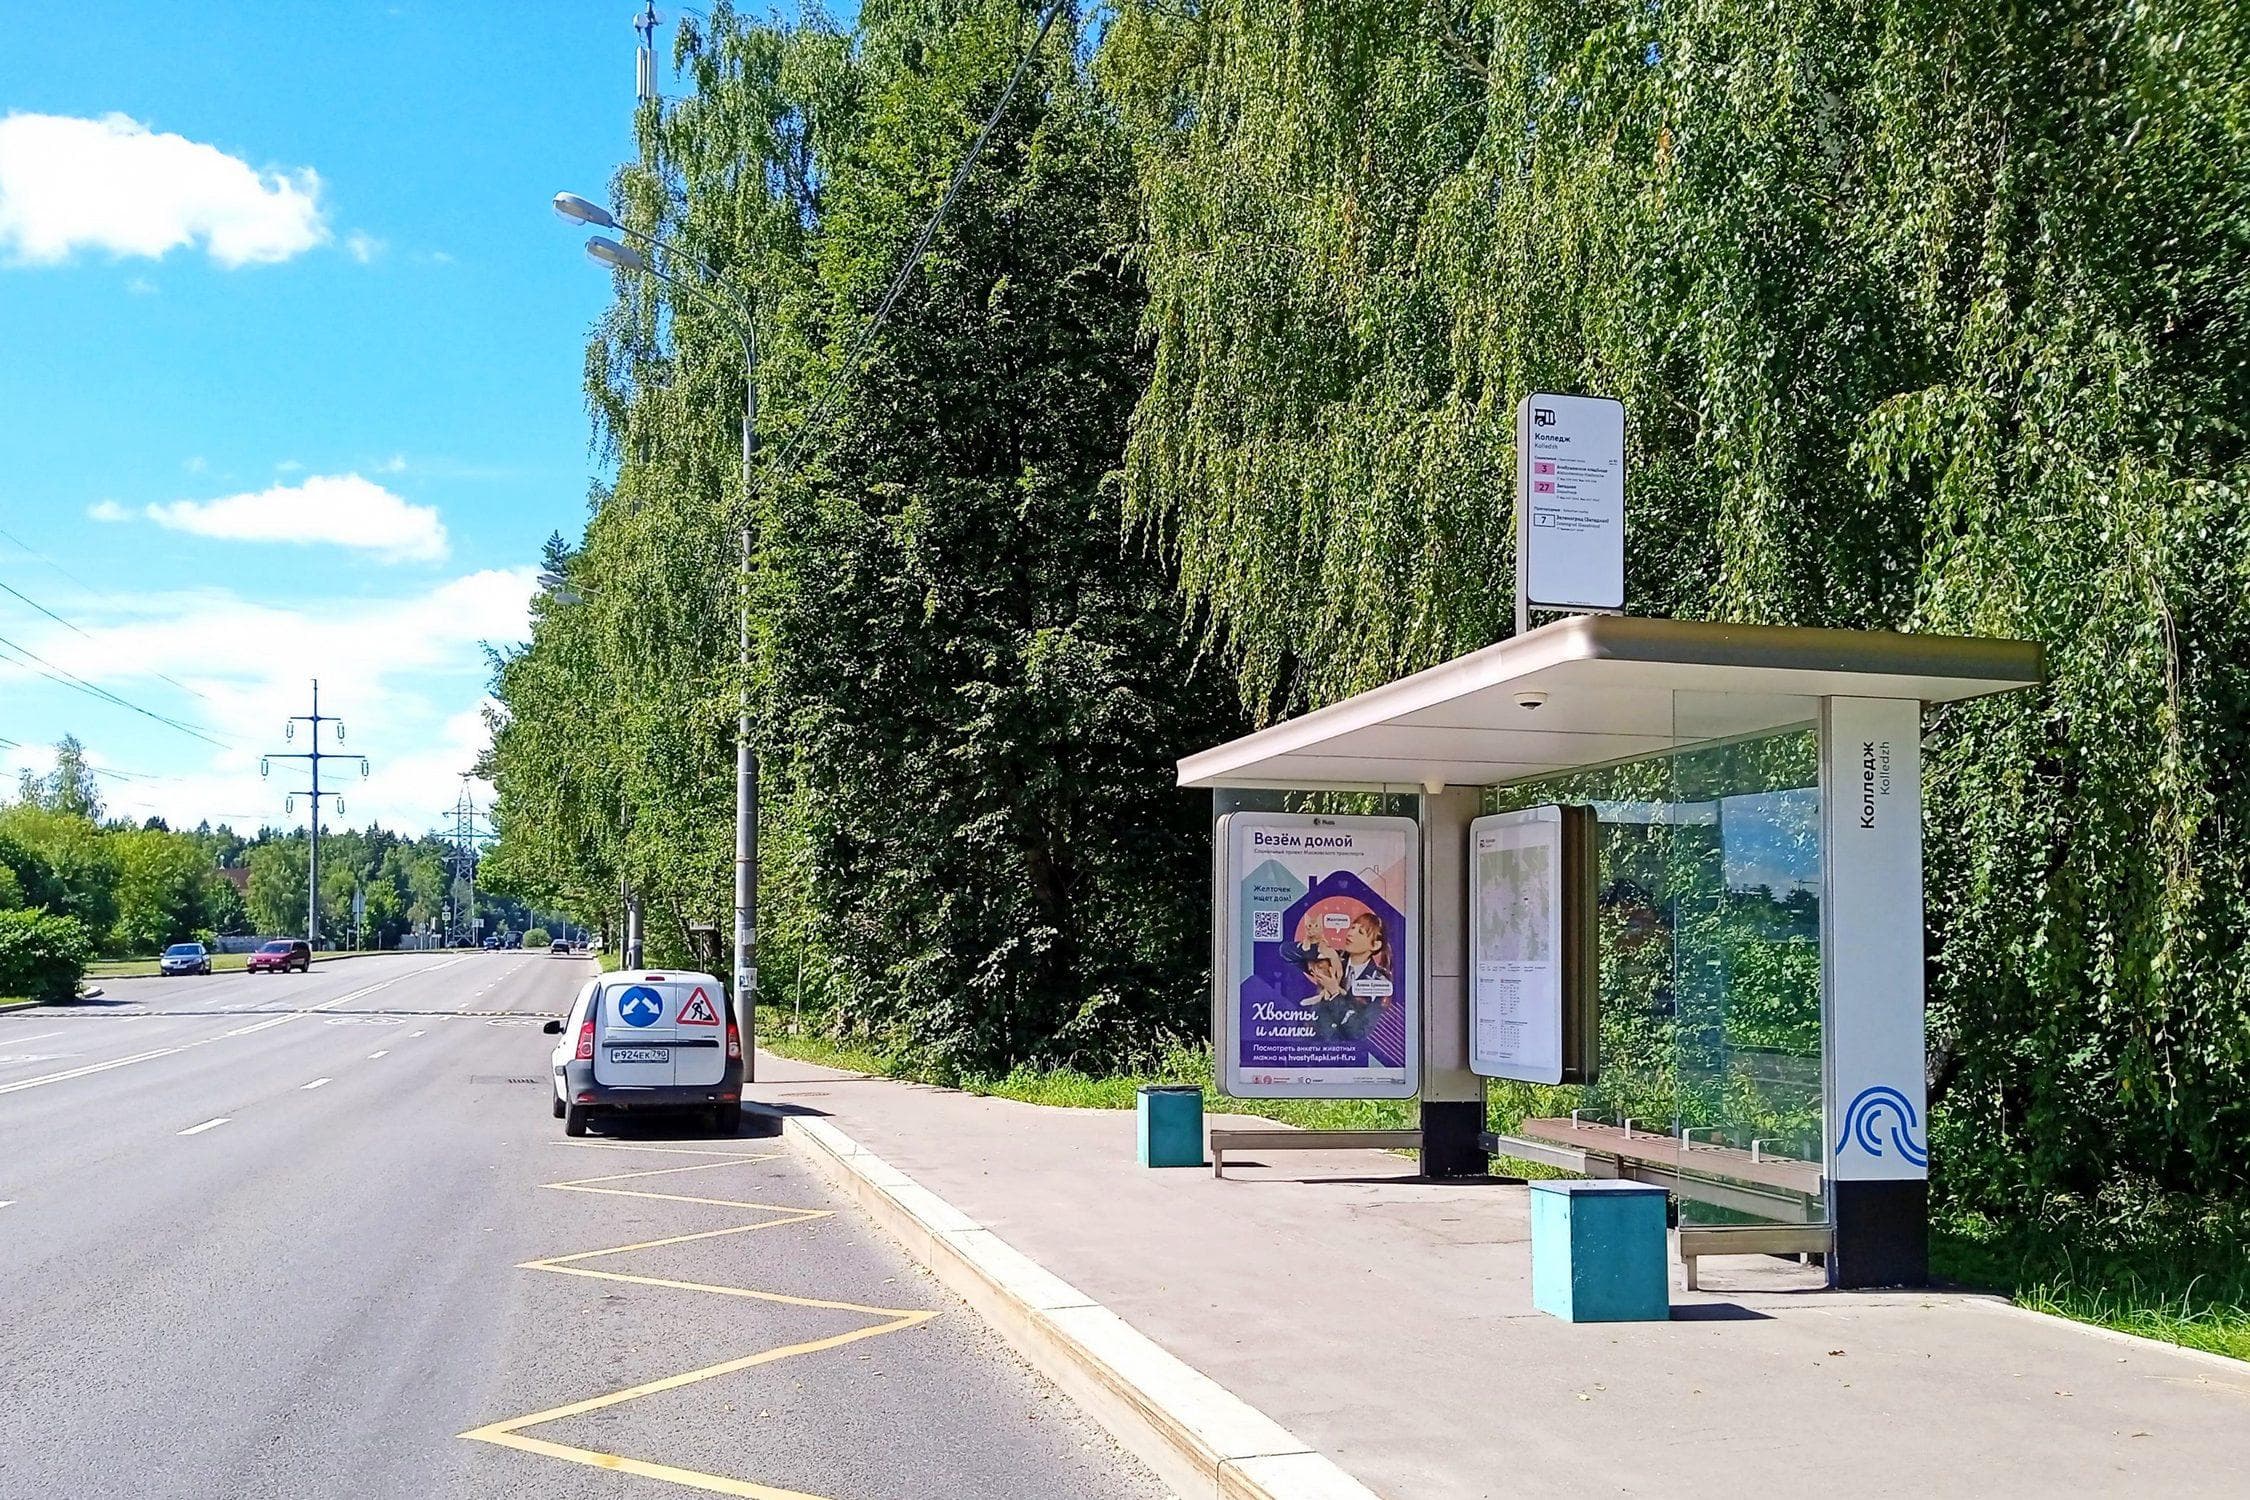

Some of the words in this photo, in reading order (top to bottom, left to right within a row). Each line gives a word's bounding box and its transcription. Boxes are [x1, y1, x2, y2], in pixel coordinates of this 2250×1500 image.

[1534, 432, 1571, 442] Колледж
[1541, 464, 1548, 473] 3
[1539, 483, 1550, 492] 27
[1541, 516, 1547, 524] 7
[1879, 741, 1890, 795] Kolledzh
[1860, 741, 1876, 829] Колледж
[1254, 832, 1301, 846] Везём
[1305, 834, 1353, 848] домой
[1253, 885, 1291, 893] Желточек
[1274, 895, 1292, 903] дом!
[1251, 1001, 1319, 1021] Хвосты
[1255, 1025, 1267, 1037] и
[1268, 1025, 1316, 1037] лапки
[1253, 1044, 1295, 1053] Посмотреть
